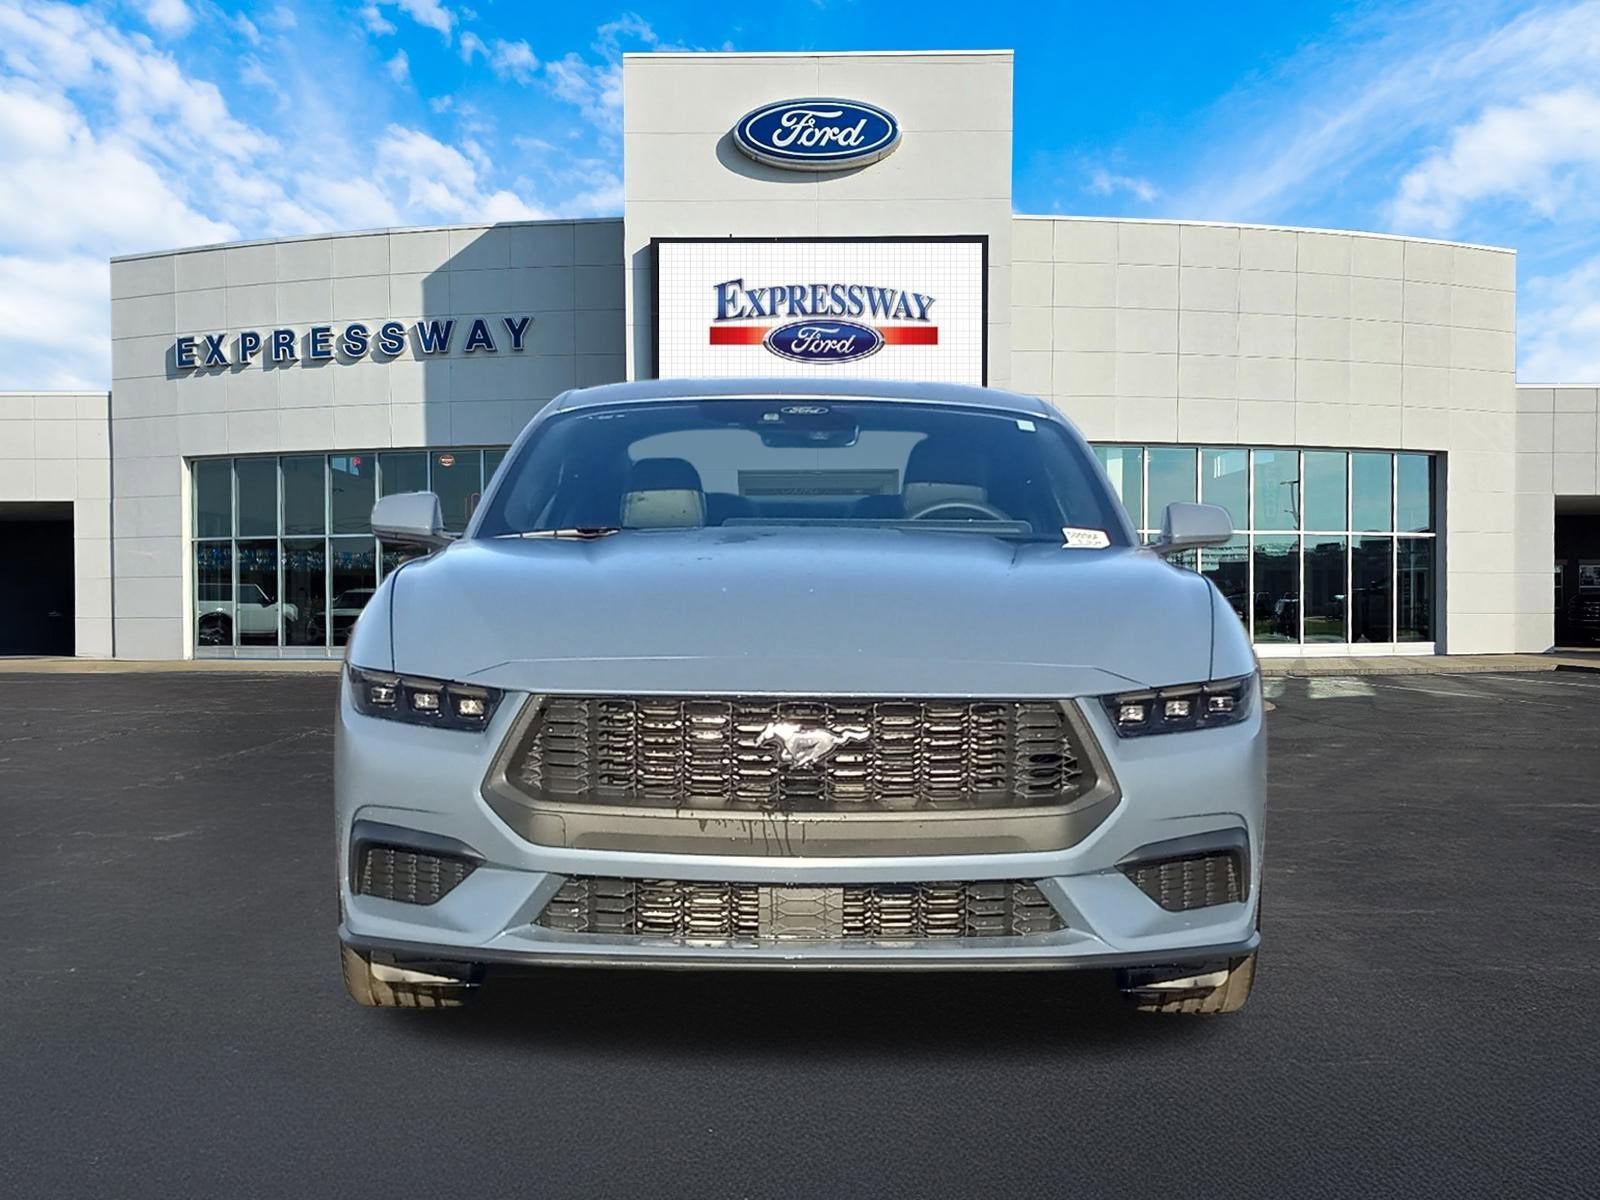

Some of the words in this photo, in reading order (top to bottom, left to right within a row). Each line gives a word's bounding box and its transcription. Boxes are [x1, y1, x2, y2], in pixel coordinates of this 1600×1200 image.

[771, 110, 866, 147] Ford
[713, 279, 935, 322] EXPRESSWAY
[174, 315, 534, 369] EXPRESSWAY
[791, 326, 855, 353] Ford
